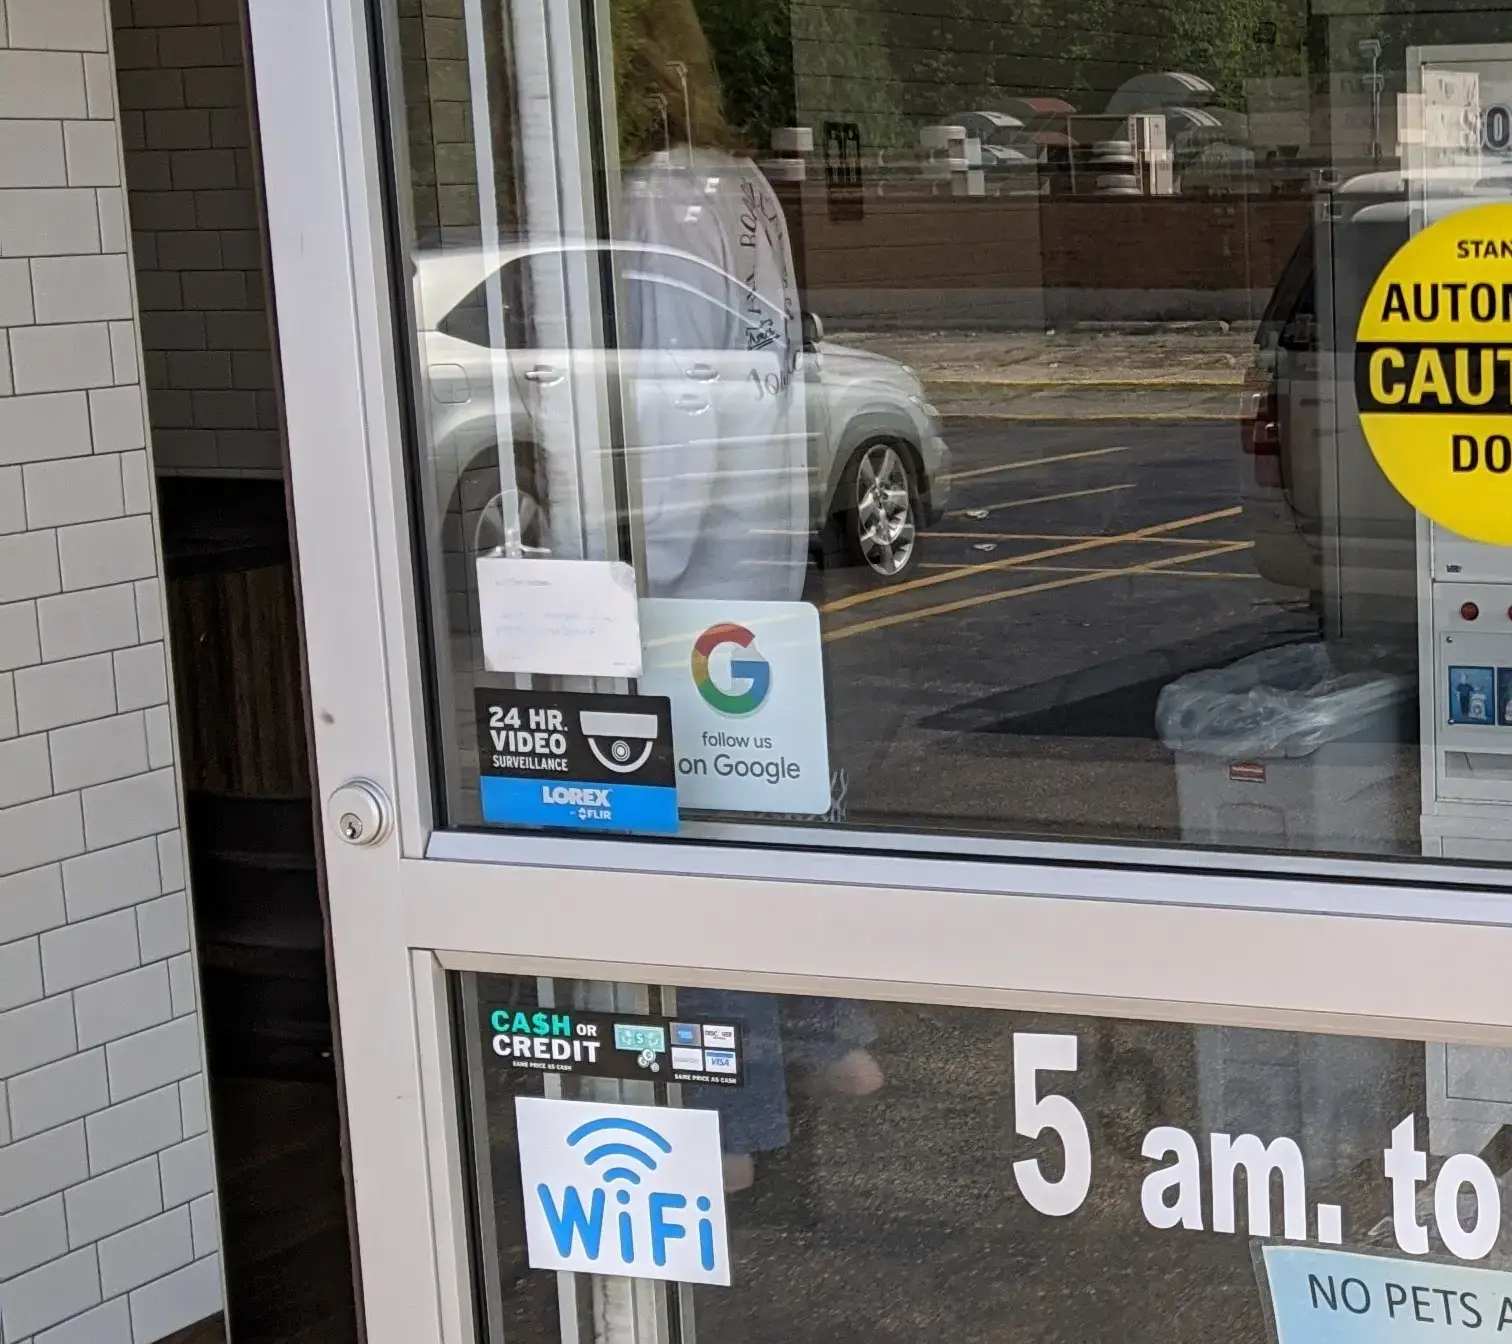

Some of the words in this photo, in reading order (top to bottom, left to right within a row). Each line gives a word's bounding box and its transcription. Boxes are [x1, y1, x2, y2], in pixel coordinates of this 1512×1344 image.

[488, 706, 521, 729] 24
[528, 708, 569, 732] HR.
[490, 729, 567, 755] VIDEO
[702, 731, 750, 748] follow
[753, 736, 772, 749] us
[493, 754, 569, 772] SURVEILLANCE
[679, 758, 708, 775] on
[713, 754, 801, 784] Google
[541, 786, 612, 808] LOREX
[587, 809, 612, 821] FLIR
[576, 1023, 598, 1037] OR
[705, 1029, 733, 1037] DISCVER
[492, 1033, 601, 1063] CREDIT
[711, 1057, 730, 1067] VISA
[720, 1076, 737, 1085] CASH
[1011, 1031, 1092, 1219] 5
[1139, 1124, 1342, 1245] am.
[1383, 1112, 1503, 1263] to
[536, 1182, 716, 1272] WiFi
[1307, 1273, 1371, 1314] NO
[1385, 1282, 1483, 1329] PETS
